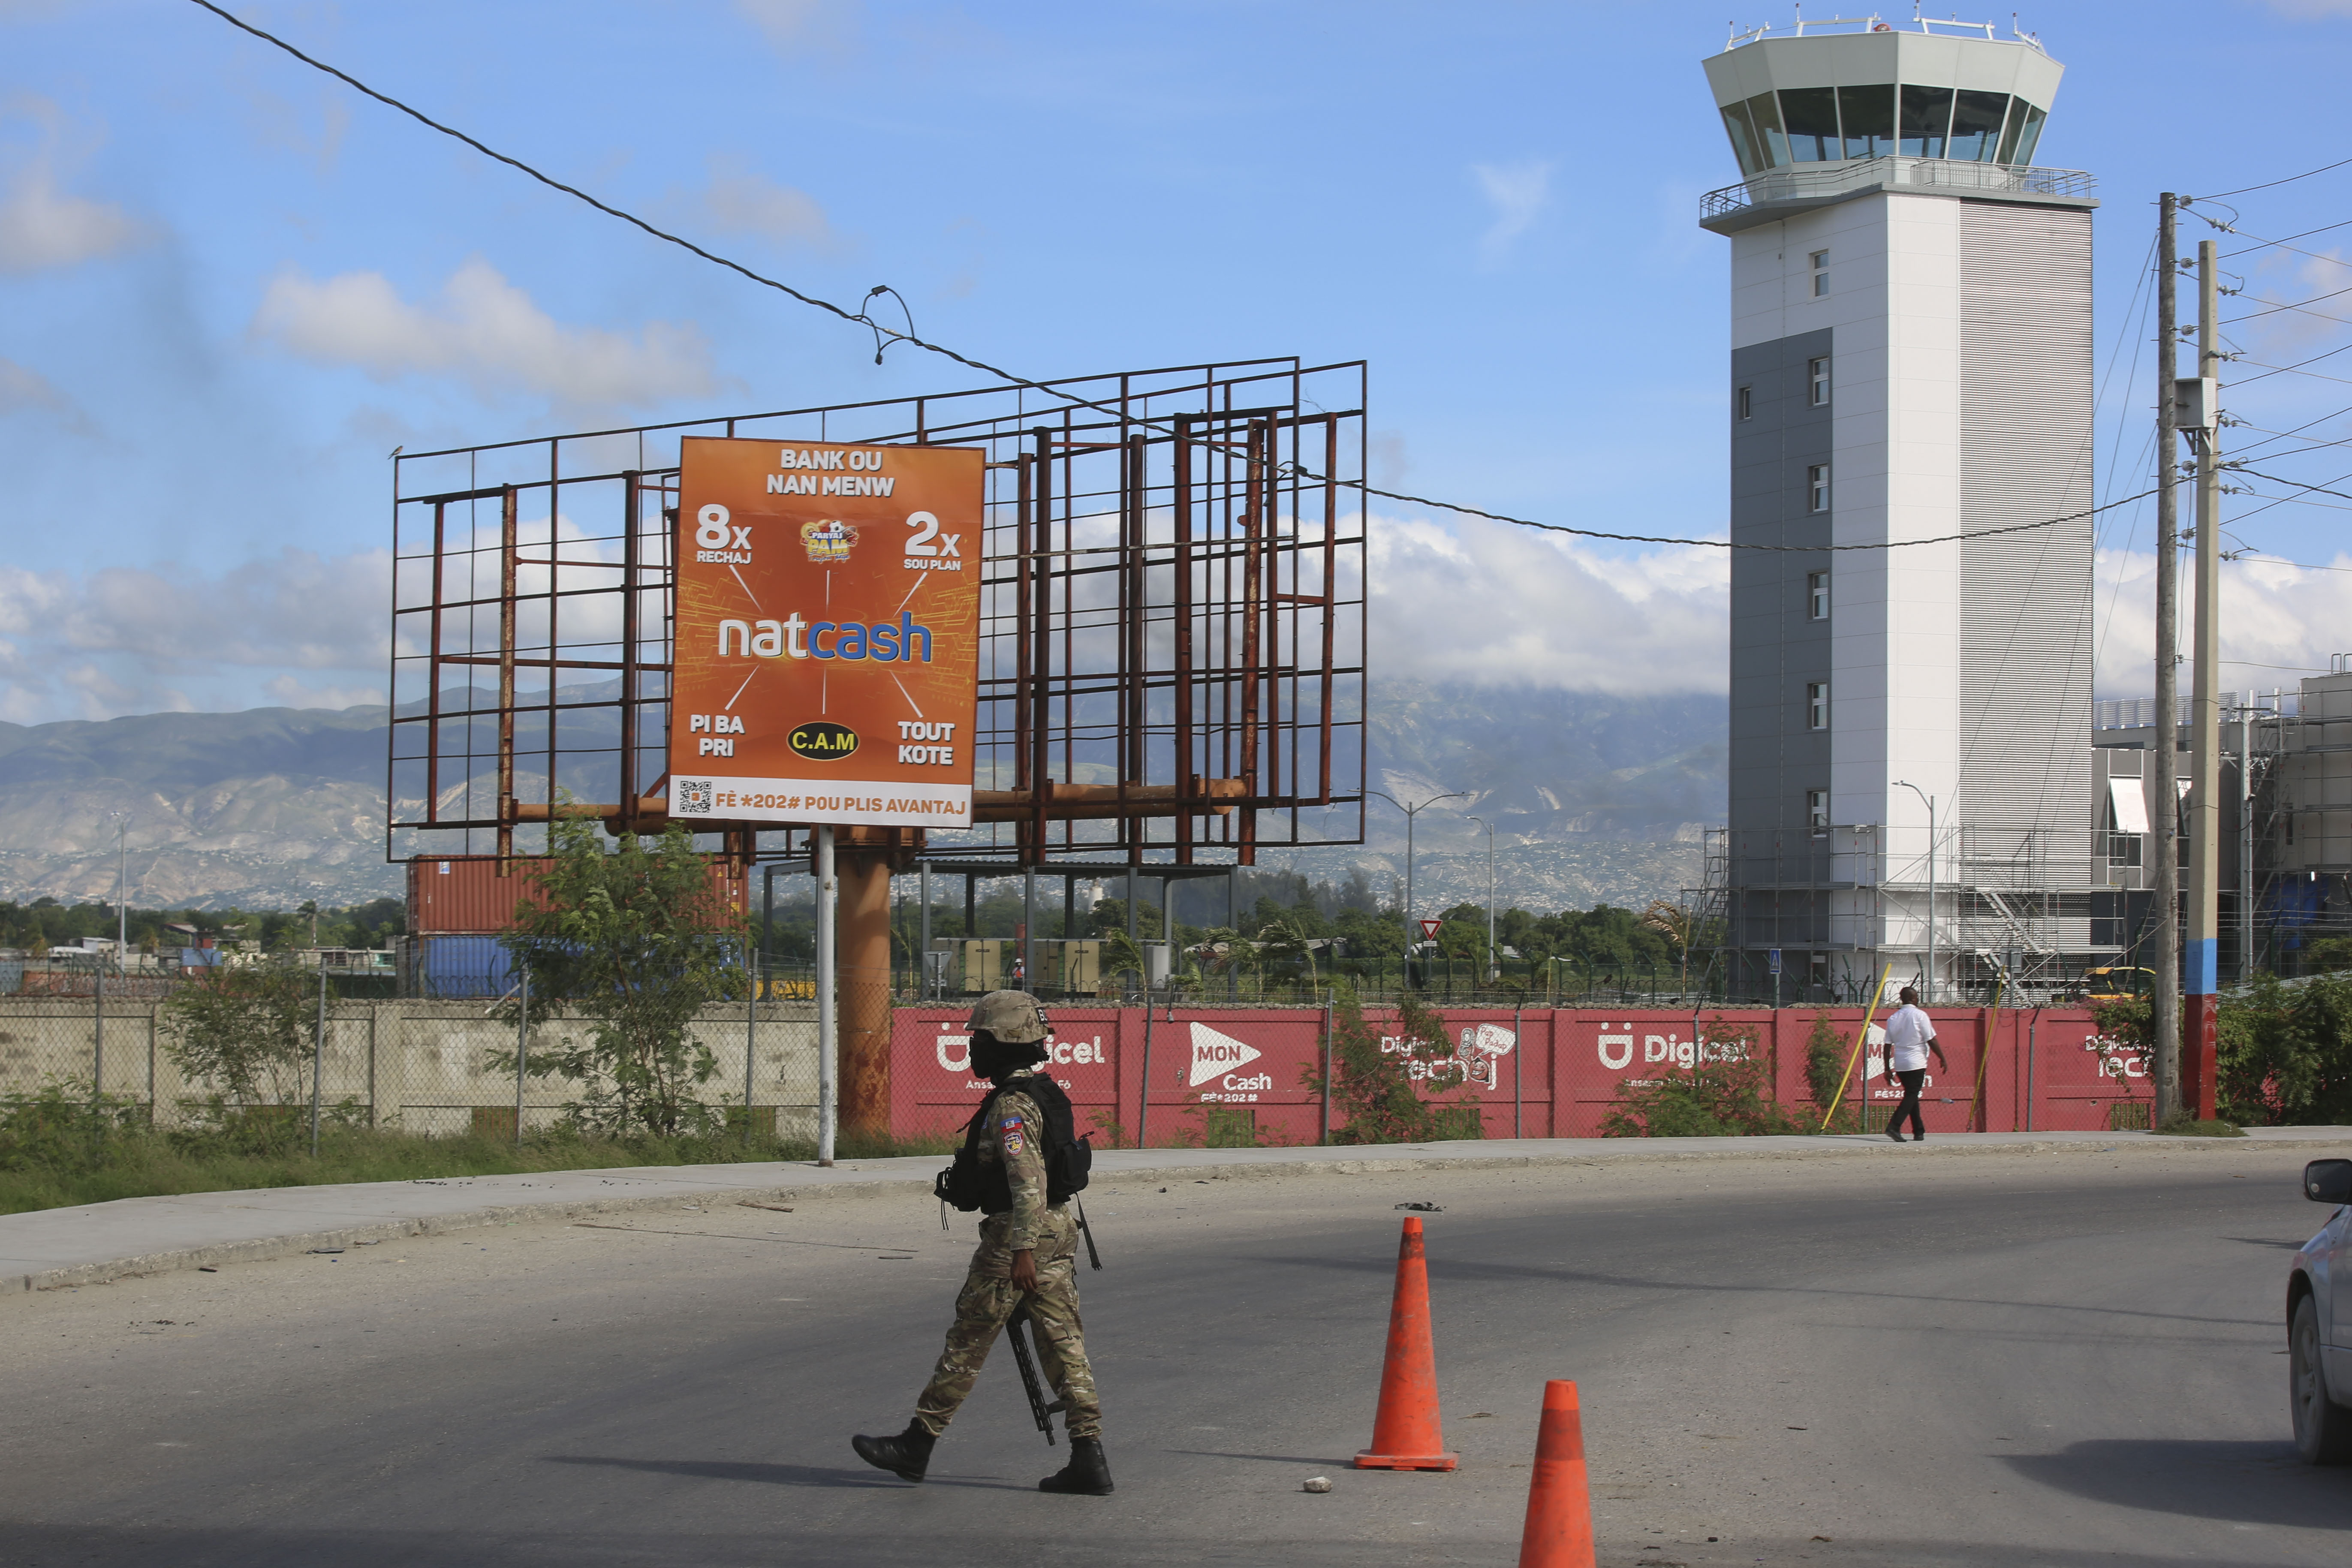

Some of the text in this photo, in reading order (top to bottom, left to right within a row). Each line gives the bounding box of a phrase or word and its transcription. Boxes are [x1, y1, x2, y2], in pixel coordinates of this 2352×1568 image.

[781, 449, 882, 471] BANK OU
[767, 474, 894, 497] NAN MENW
[807, 539, 849, 554] PAM
[696, 550, 751, 564] RECHAJ
[904, 559, 961, 571] SOU PLAN
[718, 611, 931, 662] natcash
[690, 714, 745, 734] PI BA
[898, 721, 955, 741] TOUT
[699, 738, 734, 757] PRI
[792, 731, 855, 750] C.A.M
[898, 745, 954, 765] KOTE
[716, 790, 737, 807] FÈ
[805, 796, 840, 811] POU
[844, 798, 883, 812] PLIS
[885, 799, 966, 815] AVANTAJ
[1198, 1045, 1241, 1062] MON
[1645, 1034, 1750, 1069] Digicel
[1223, 1072, 1272, 1091] Cash
